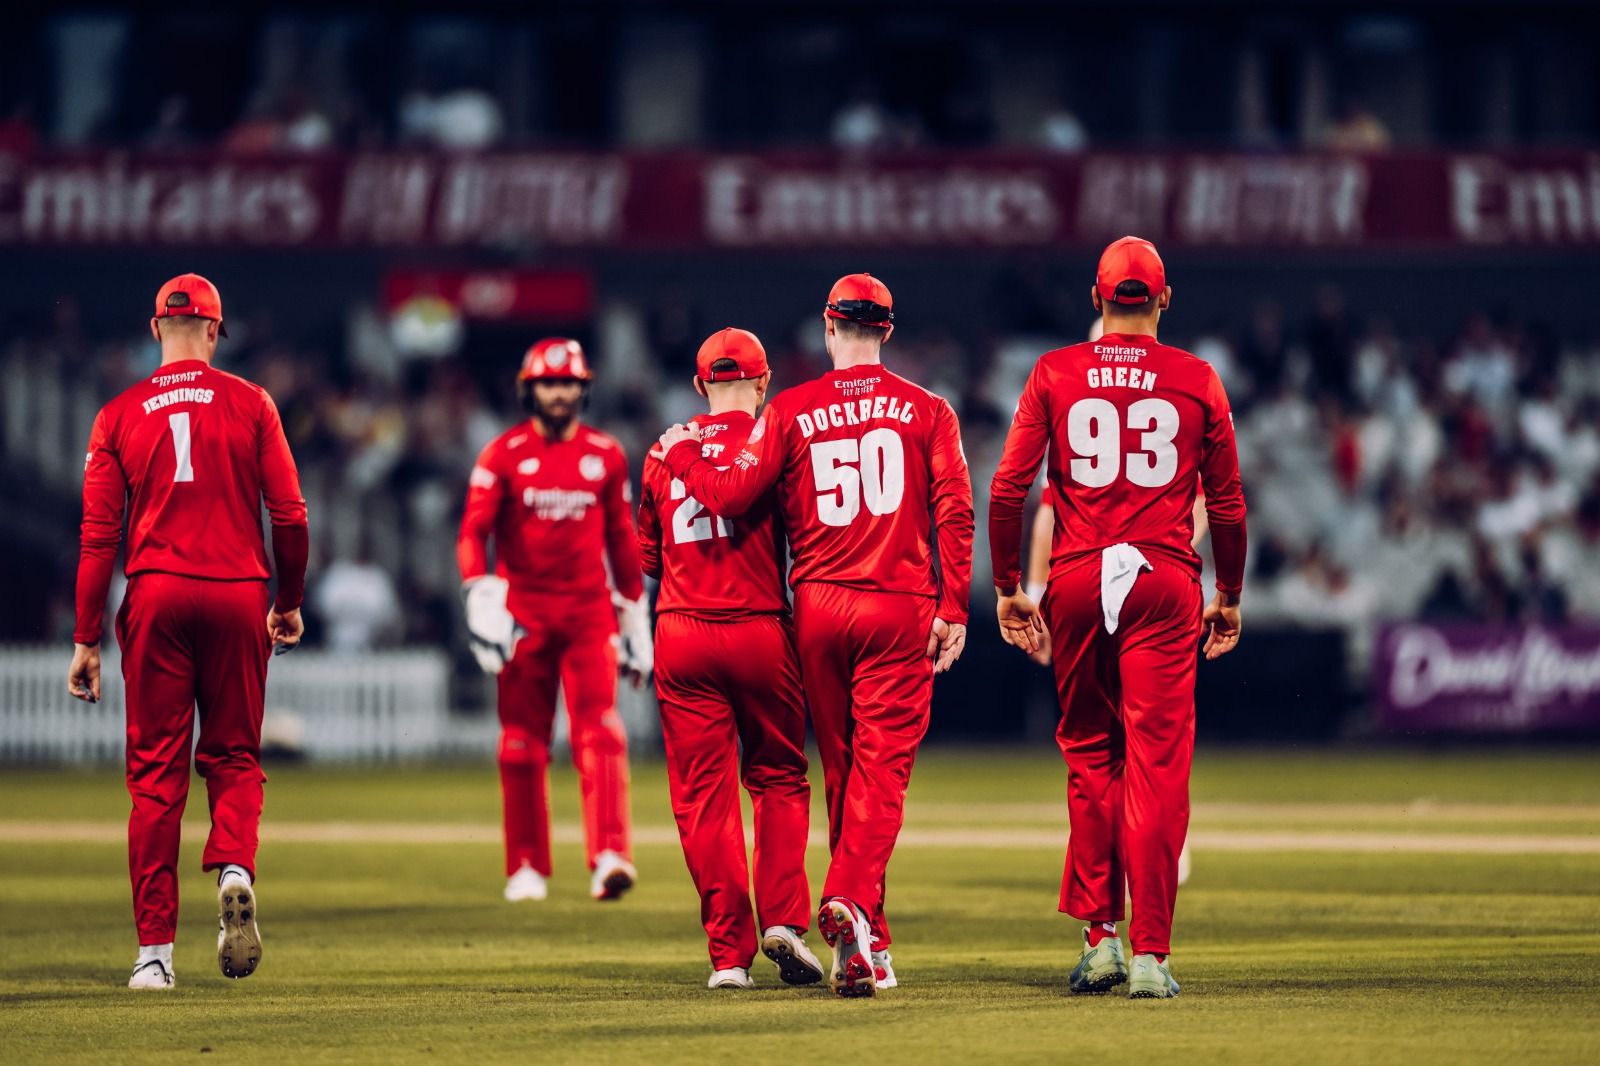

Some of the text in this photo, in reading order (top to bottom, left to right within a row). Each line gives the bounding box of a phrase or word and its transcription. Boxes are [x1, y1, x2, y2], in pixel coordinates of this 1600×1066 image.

[1094, 345, 1147, 356] Emirates
[834, 376, 881, 388] Emirates
[1087, 367, 1157, 391] GREEN
[142, 388, 214, 414] JENNINGS
[169, 412, 194, 482] 1
[701, 443, 726, 458] ST
[1068, 398, 1179, 487] 93
[810, 428, 905, 526] 50
